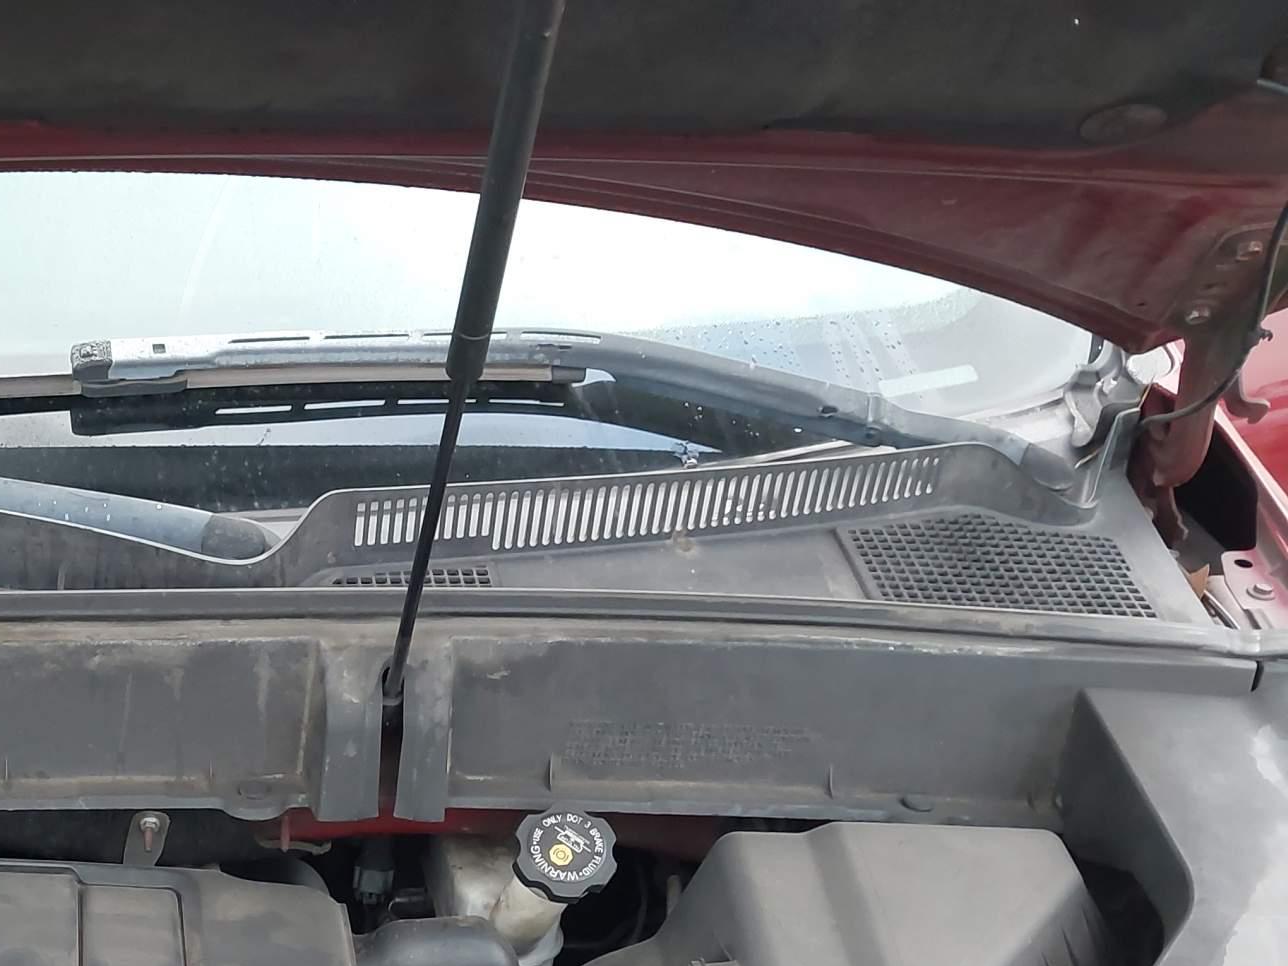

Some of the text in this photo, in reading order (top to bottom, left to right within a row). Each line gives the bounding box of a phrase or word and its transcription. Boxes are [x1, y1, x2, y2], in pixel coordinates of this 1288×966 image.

[530, 813, 604, 881] WARNING USE ONLY DOT 3 BRAKE FLUID
